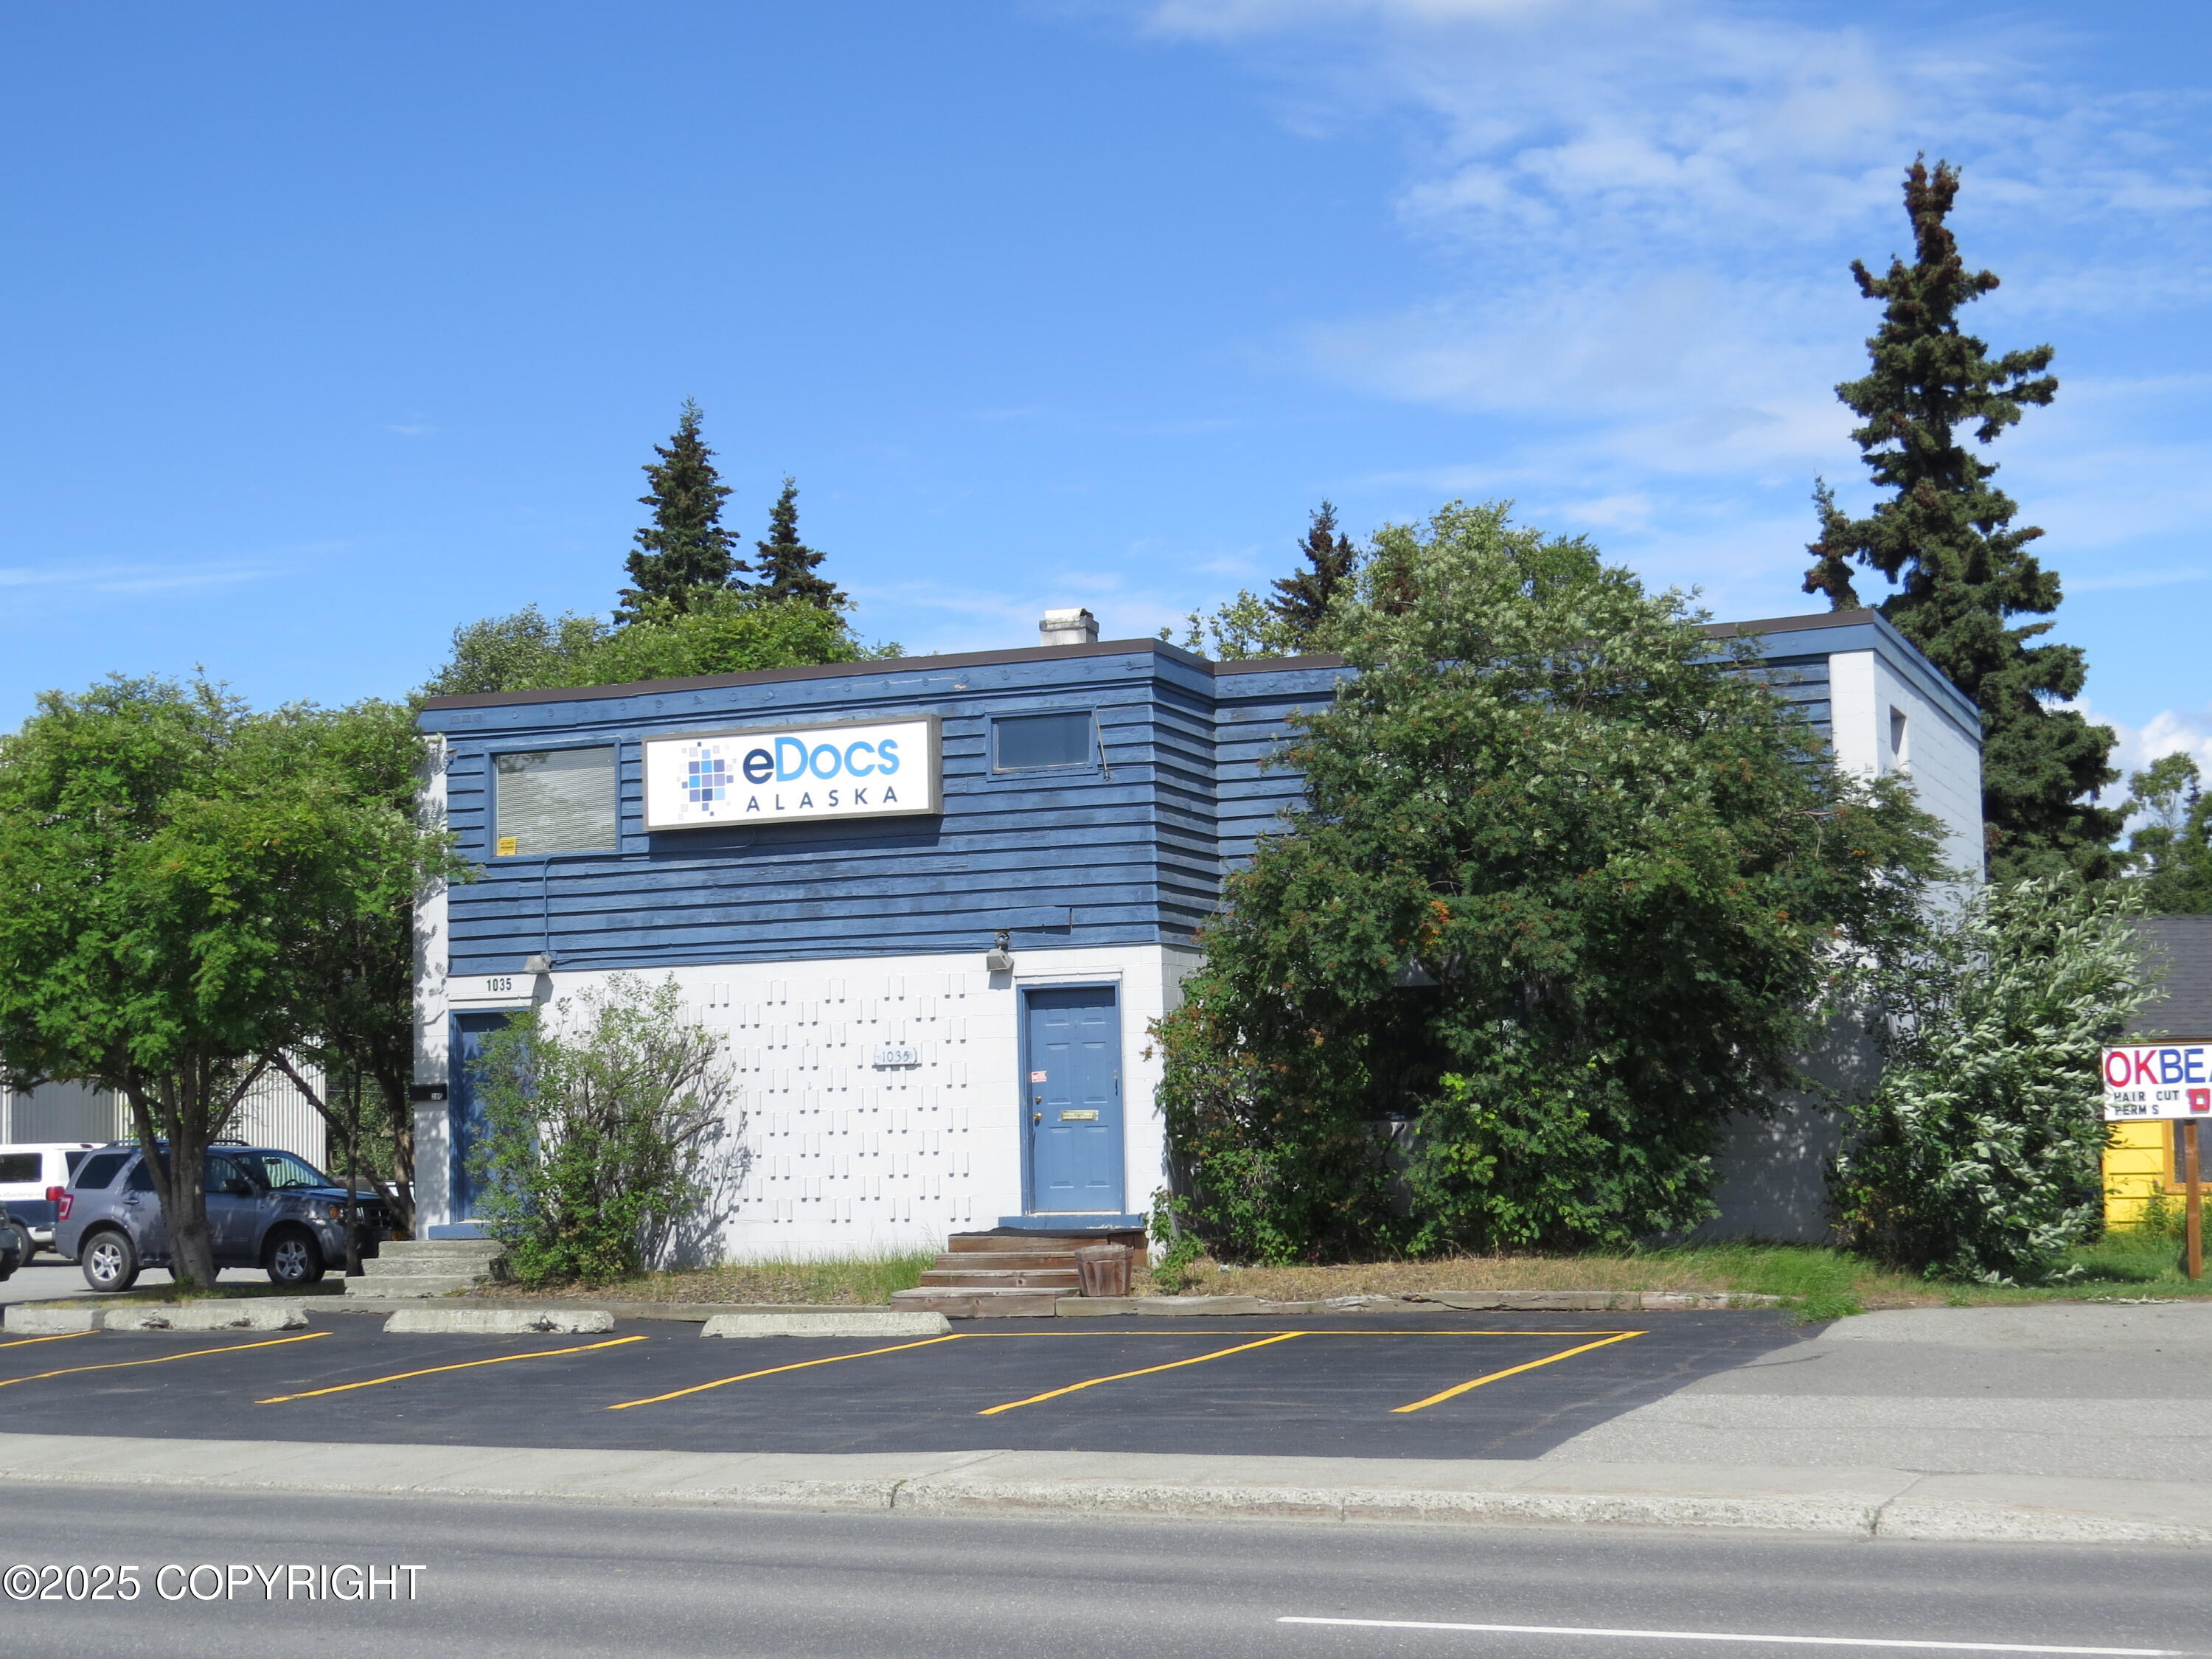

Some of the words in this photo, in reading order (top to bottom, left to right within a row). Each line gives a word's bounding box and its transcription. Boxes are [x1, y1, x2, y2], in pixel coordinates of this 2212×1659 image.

[746, 786, 898, 812] ALASKA
[487, 978, 512, 991] 1035
[883, 1051, 909, 1062] 1035
[2105, 1048, 2212, 1087] OKBE
[2114, 1091, 2146, 1102] HAIR
[2156, 1091, 2179, 1101] CUT
